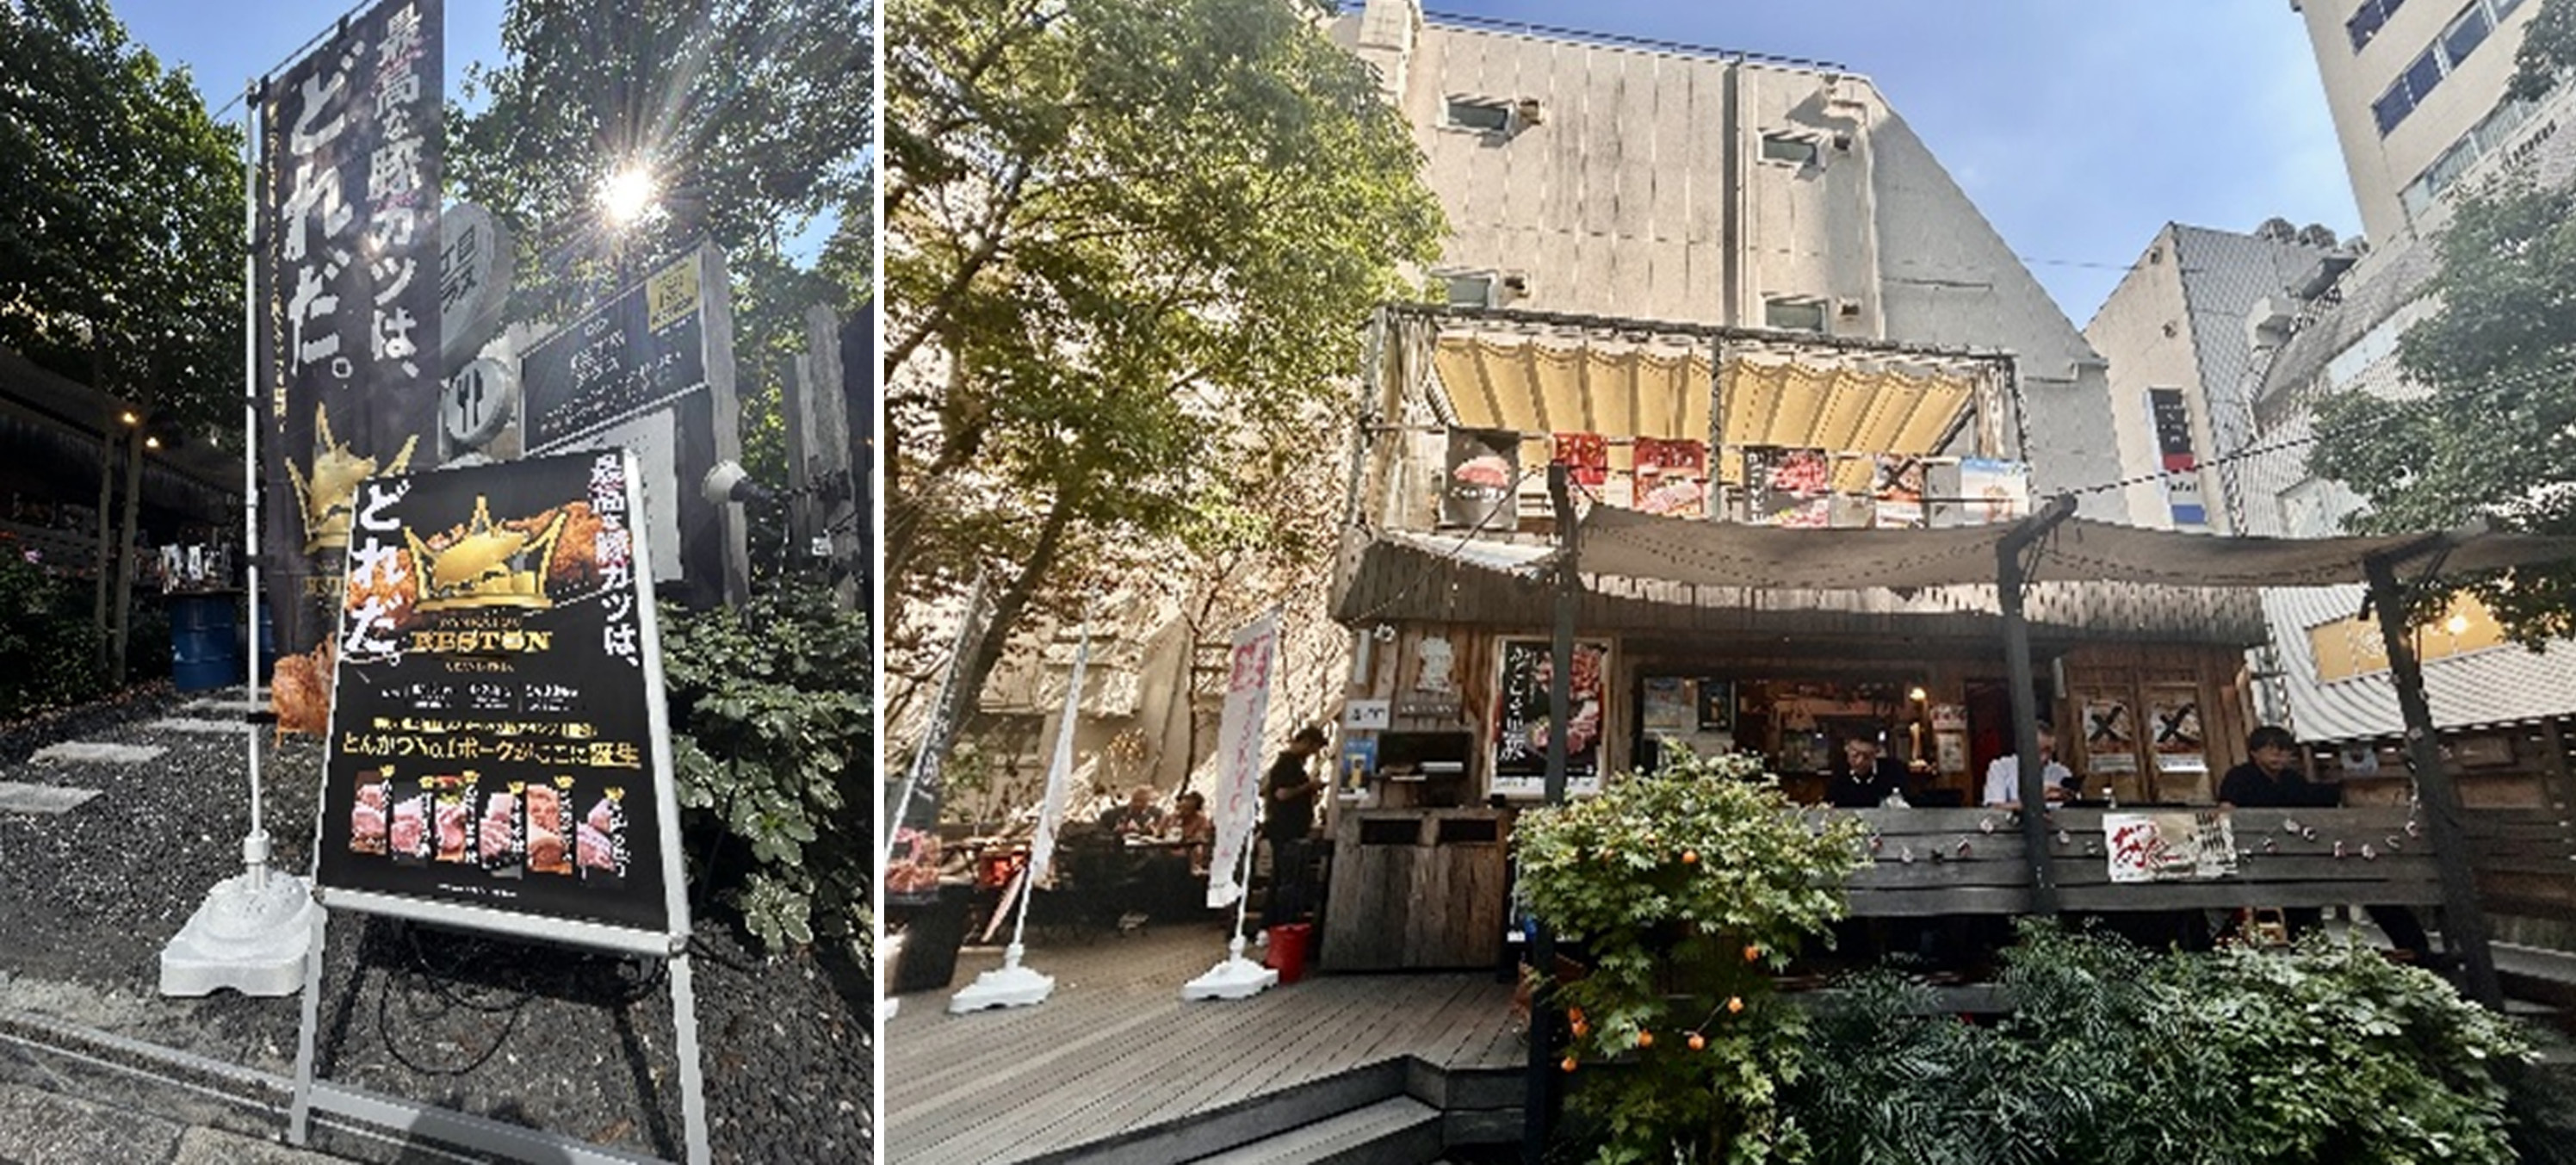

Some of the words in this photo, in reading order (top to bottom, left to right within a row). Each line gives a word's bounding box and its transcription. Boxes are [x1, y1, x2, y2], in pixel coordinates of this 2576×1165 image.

[283, 40, 365, 376] どれだ。
[368, 2, 424, 377] 最高な豚カツは、
[344, 478, 411, 666] どれだ。
[588, 454, 639, 666] 最高な豚カツは、
